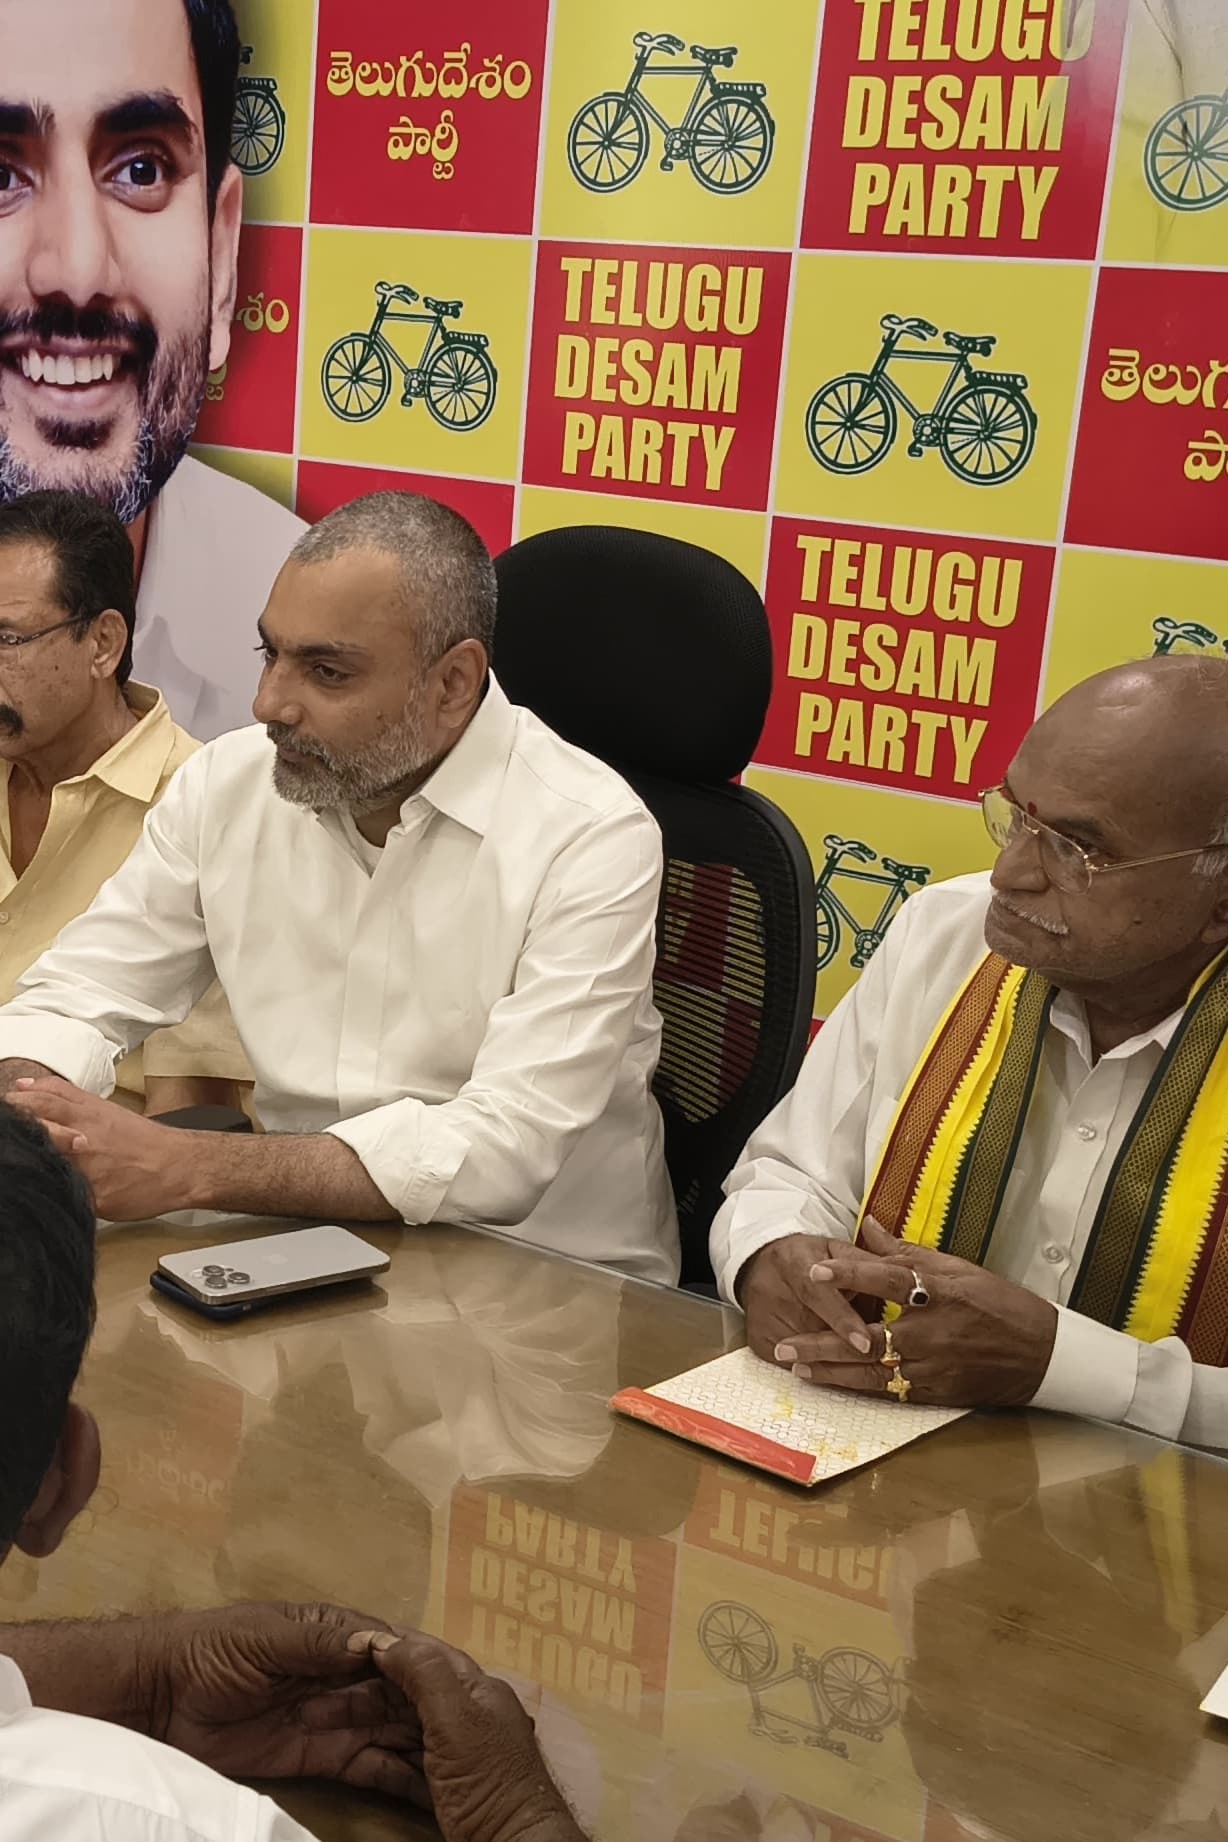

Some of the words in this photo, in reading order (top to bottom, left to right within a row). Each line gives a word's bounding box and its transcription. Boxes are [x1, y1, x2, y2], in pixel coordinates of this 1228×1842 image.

[326, 41, 533, 100] తెలుగుదేశం
[854, 0, 1097, 62] TELUGU
[387, 109, 460, 181] పార్టీ
[841, 74, 1070, 151] DESAM
[848, 162, 1060, 241] PARTY
[560, 257, 765, 336] TELUGU
[553, 334, 744, 414] DESAM
[561, 411, 737, 492] PARTY
[796, 535, 1024, 628] TELUGU
[786, 612, 998, 708] DESAM
[793, 691, 989, 785] PARTY
